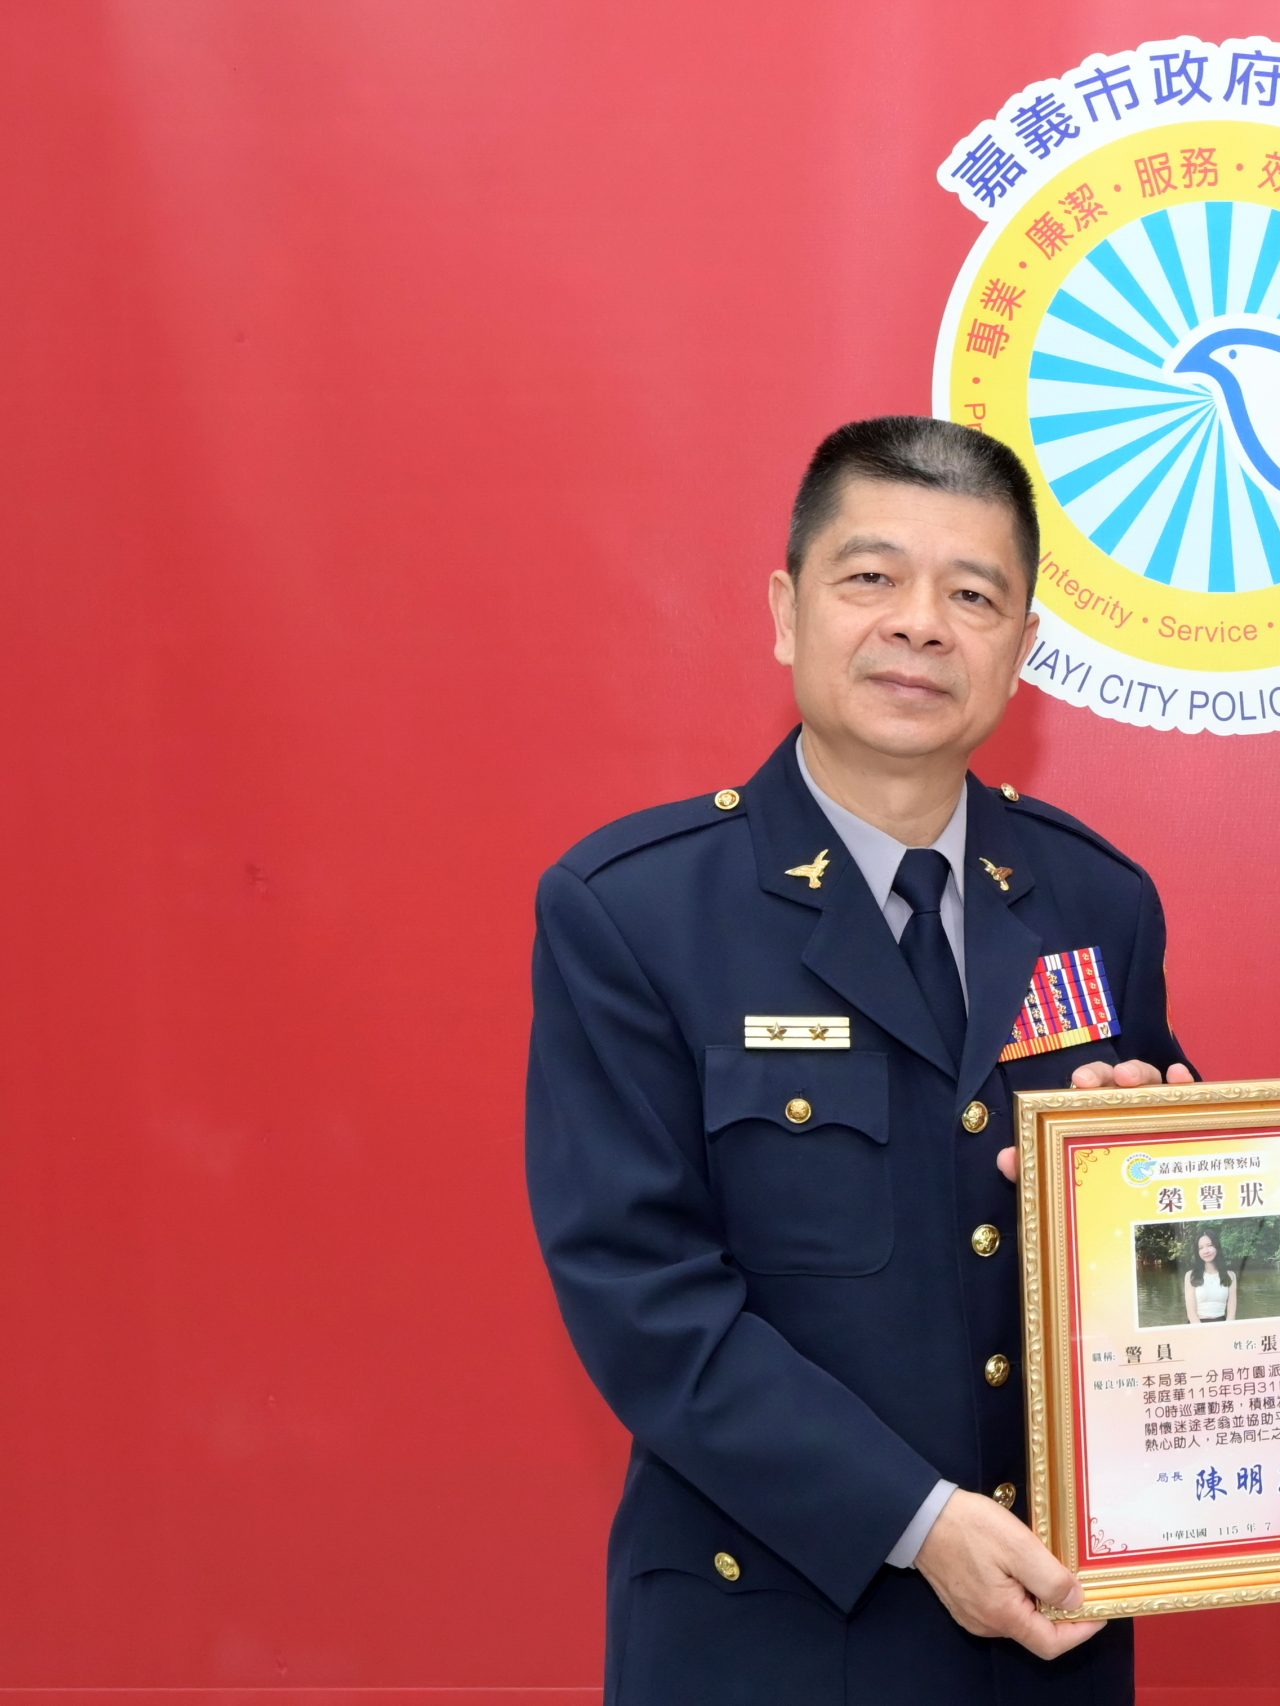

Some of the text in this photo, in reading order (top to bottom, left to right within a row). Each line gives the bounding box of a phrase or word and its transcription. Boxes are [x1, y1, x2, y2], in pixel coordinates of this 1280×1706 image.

[966, 278, 1026, 359] 專業
[1025, 183, 1108, 260] 廉潔
[1134, 147, 1218, 198] 服務
[1039, 551, 1133, 628] Integrity
[1158, 616, 1258, 643] Service
[1027, 640, 1092, 693] IAYI
[1100, 674, 1179, 717] CITY
[1159, 1156, 1261, 1175] 嘉義市政府警察局
[1159, 1182, 1263, 1212] 榮譽狀
[1125, 1343, 1172, 1363] 警員
[1156, 1471, 1183, 1482] 局長
[1163, 1528, 1207, 1541] 中華民國
[1219, 1526, 1239, 1536] 115
